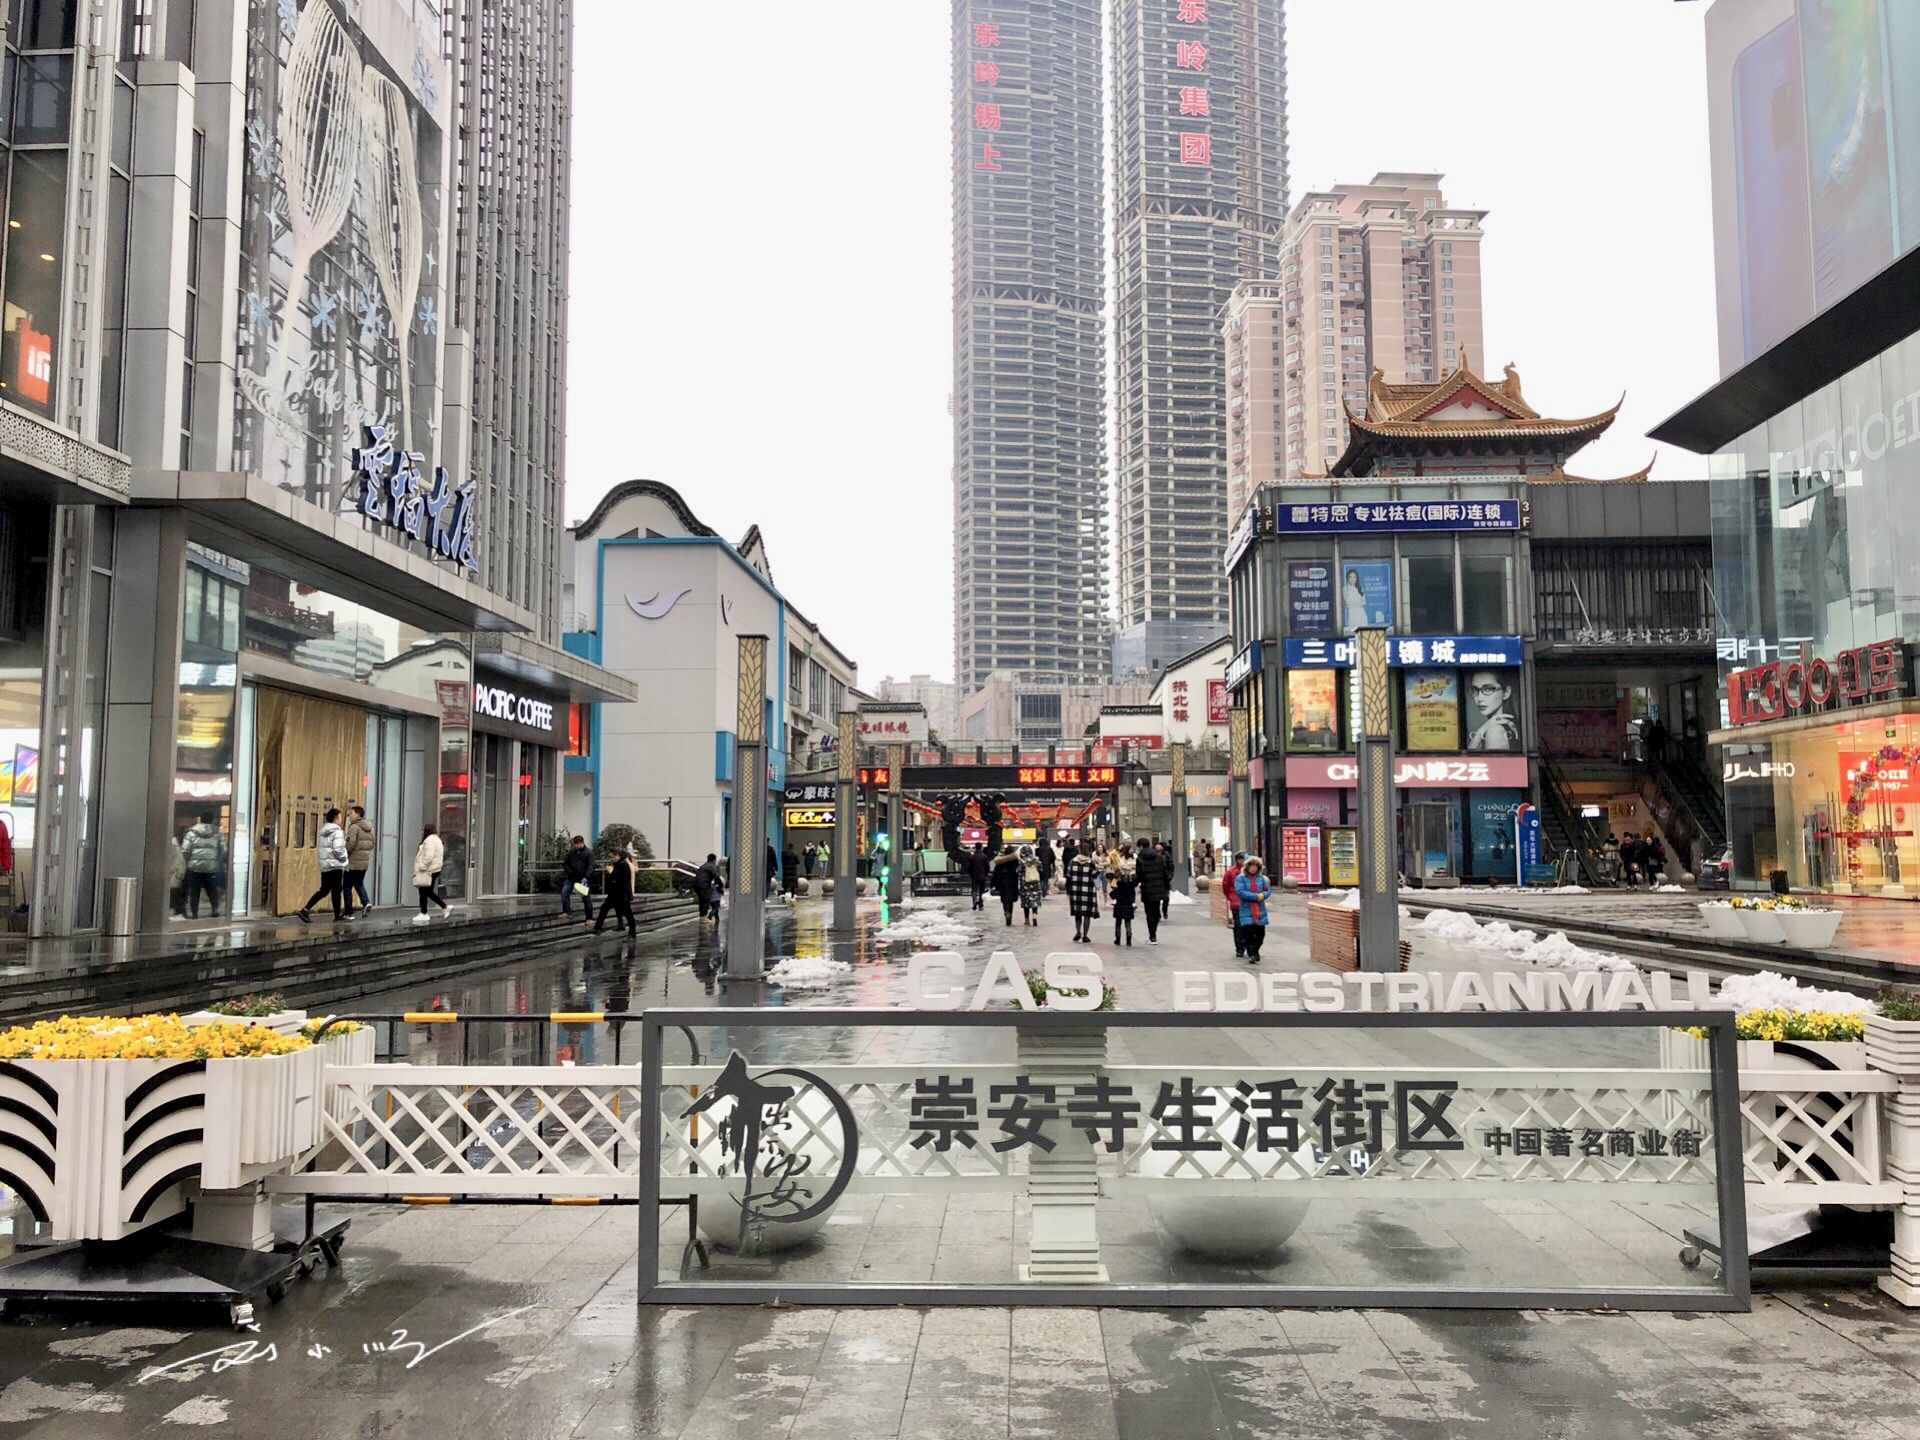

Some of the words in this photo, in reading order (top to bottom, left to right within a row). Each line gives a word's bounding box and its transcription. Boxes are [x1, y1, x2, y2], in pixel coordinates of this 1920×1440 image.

[974, 22, 1002, 171] 东岭锡上
[1176, 0, 1211, 165] 东岭集团
[1301, 639, 1457, 665] 三叶镜城
[475, 683, 516, 721] PACIFIC
[517, 696, 553, 732] COFFEE
[1019, 768, 1046, 783] 富强
[1053, 768, 1080, 783] 民主
[1087, 768, 1115, 783] 文明
[906, 951, 1104, 1011] CAS
[1173, 970, 1730, 1013] EDESTRIANMALL
[909, 1075, 1463, 1155] 崇安寺生活街区
[1484, 1127, 1703, 1159] 中国著名商业街
